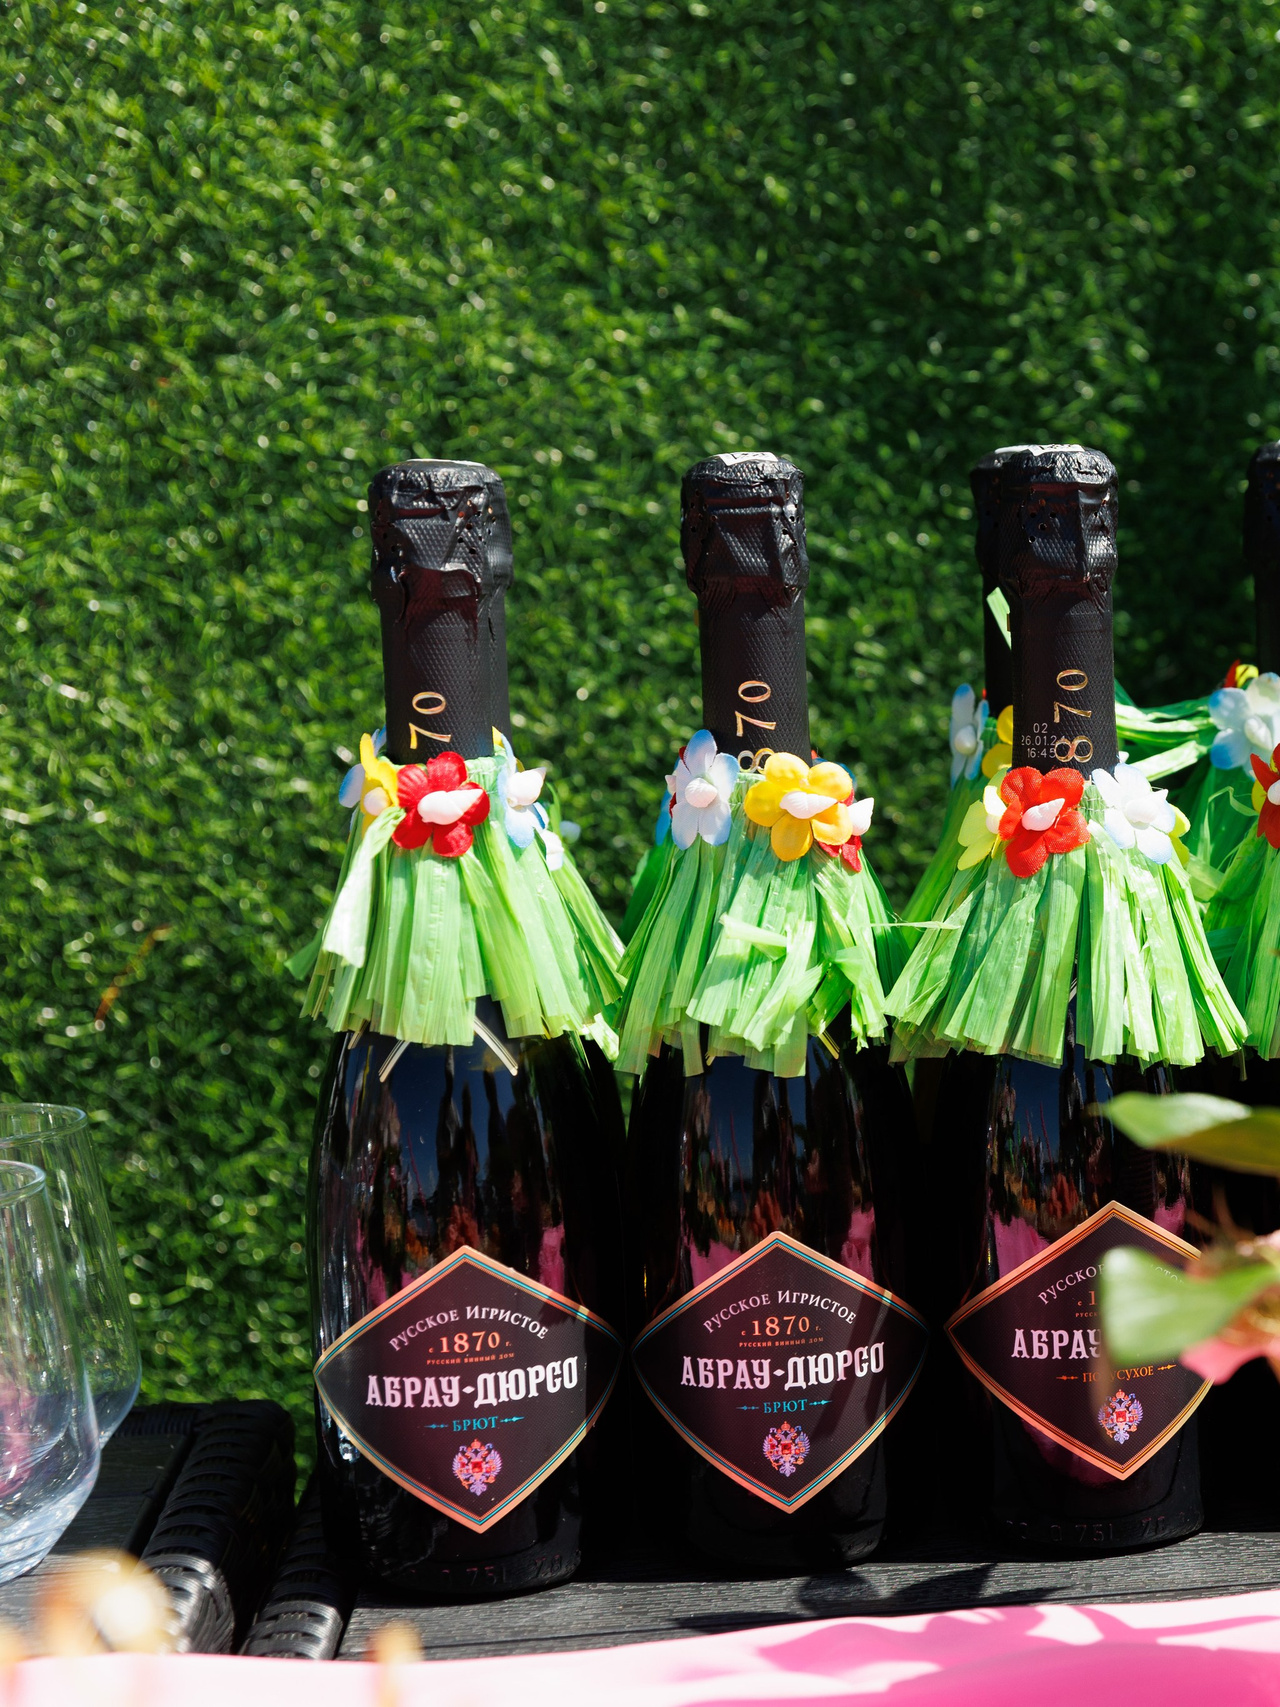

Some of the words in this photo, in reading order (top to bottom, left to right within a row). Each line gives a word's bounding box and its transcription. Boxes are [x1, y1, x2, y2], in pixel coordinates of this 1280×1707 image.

[1054, 669, 1094, 763] 870
[1033, 722, 1048, 734] 02
[752, 1315, 810, 1337] 1870
[440, 1331, 501, 1353] 1870
[680, 1342, 885, 1391] АБРАУ-ДЮРСО
[1082, 1365, 1154, 1383] ПОУСУХОЕ
[365, 1356, 579, 1408] АБРАУ-ДЮРСО
[763, 1399, 808, 1414] БРЮТ
[452, 1416, 499, 1432] БРЮТ
